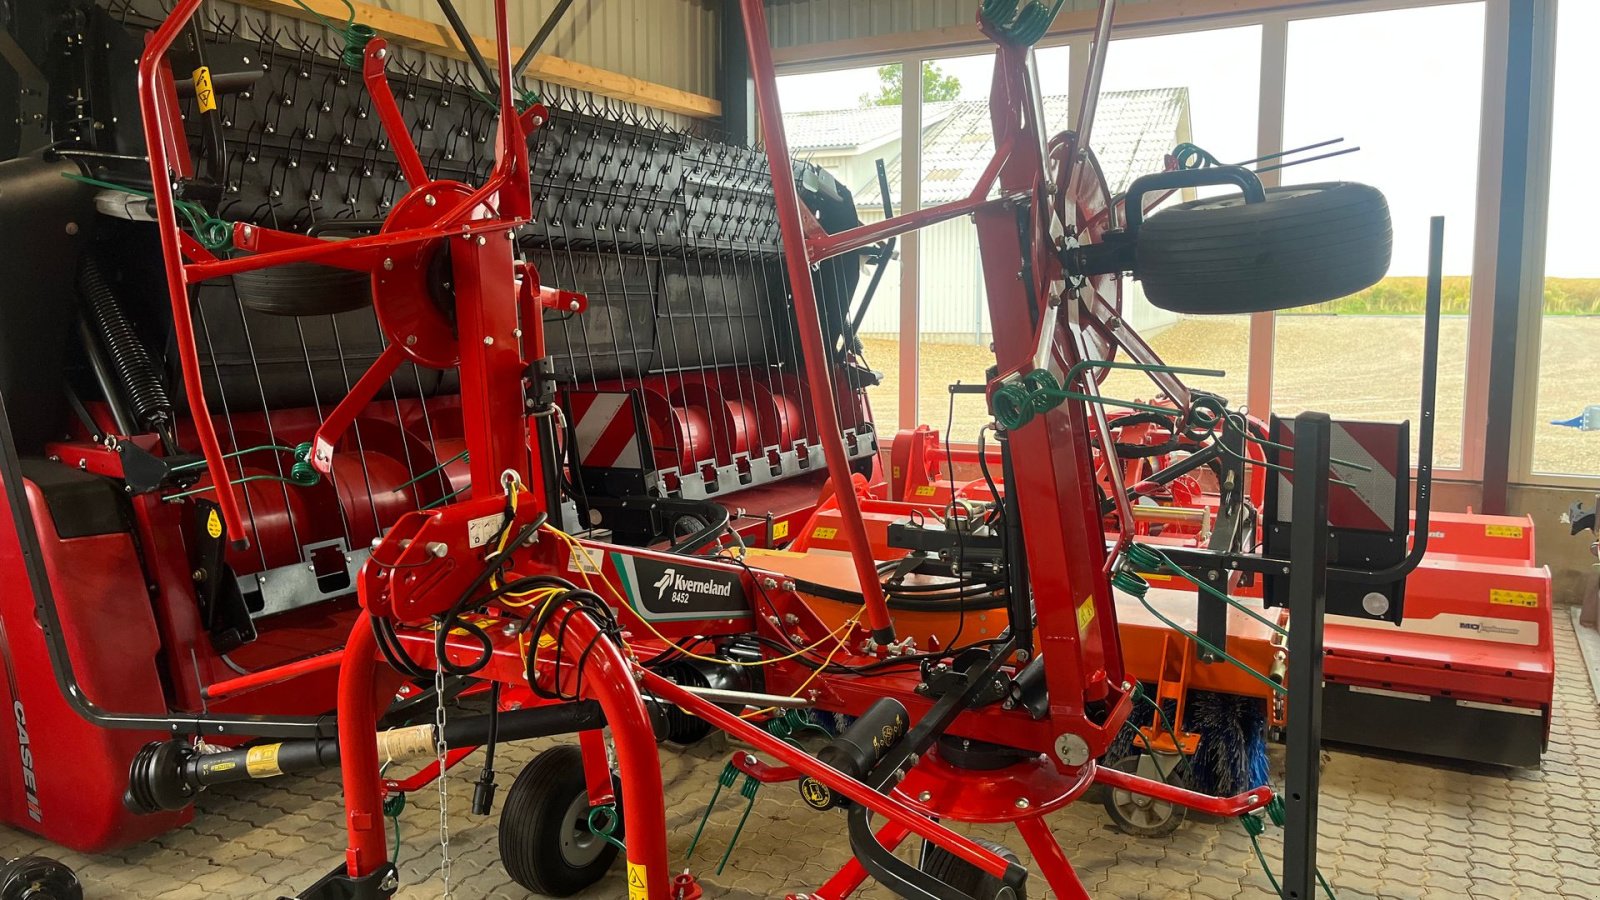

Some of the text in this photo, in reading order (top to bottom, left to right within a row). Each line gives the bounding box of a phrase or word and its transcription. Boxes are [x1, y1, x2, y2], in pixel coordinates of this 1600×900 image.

[674, 574, 731, 596] Kverneland
[672, 592, 689, 603] 8452
[14, 700, 37, 792] CASE
